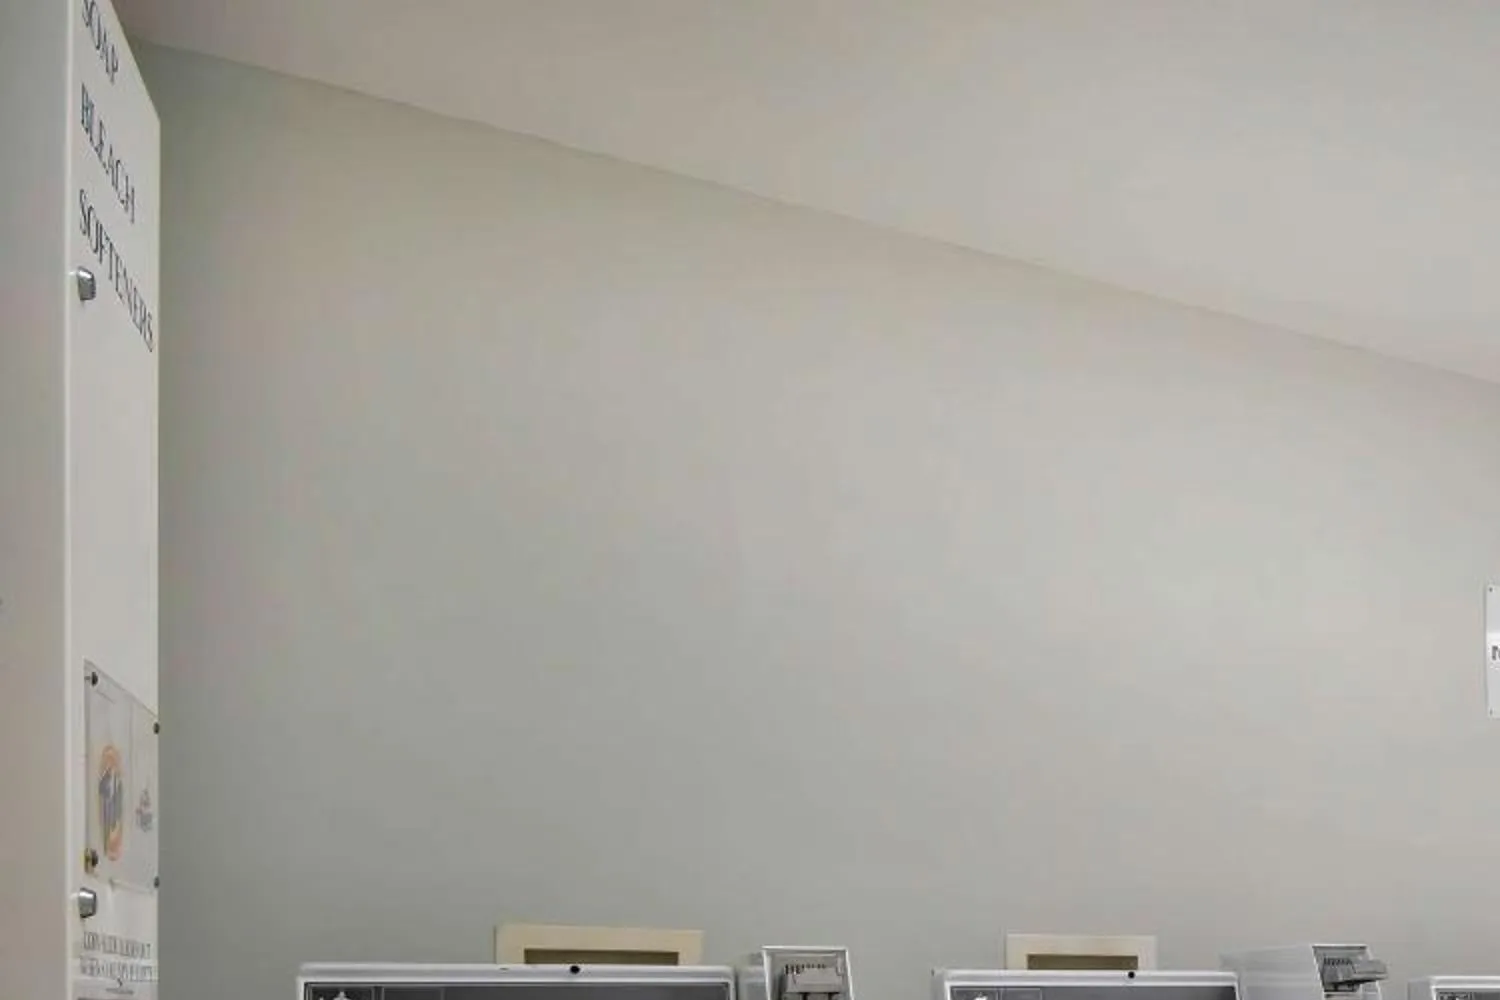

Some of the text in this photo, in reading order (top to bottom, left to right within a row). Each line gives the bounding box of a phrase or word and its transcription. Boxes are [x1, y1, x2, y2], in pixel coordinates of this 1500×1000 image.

[82, 0, 119, 84] SOAP
[80, 82, 136, 224] BLEACH
[79, 188, 154, 352] SOFTENERS
